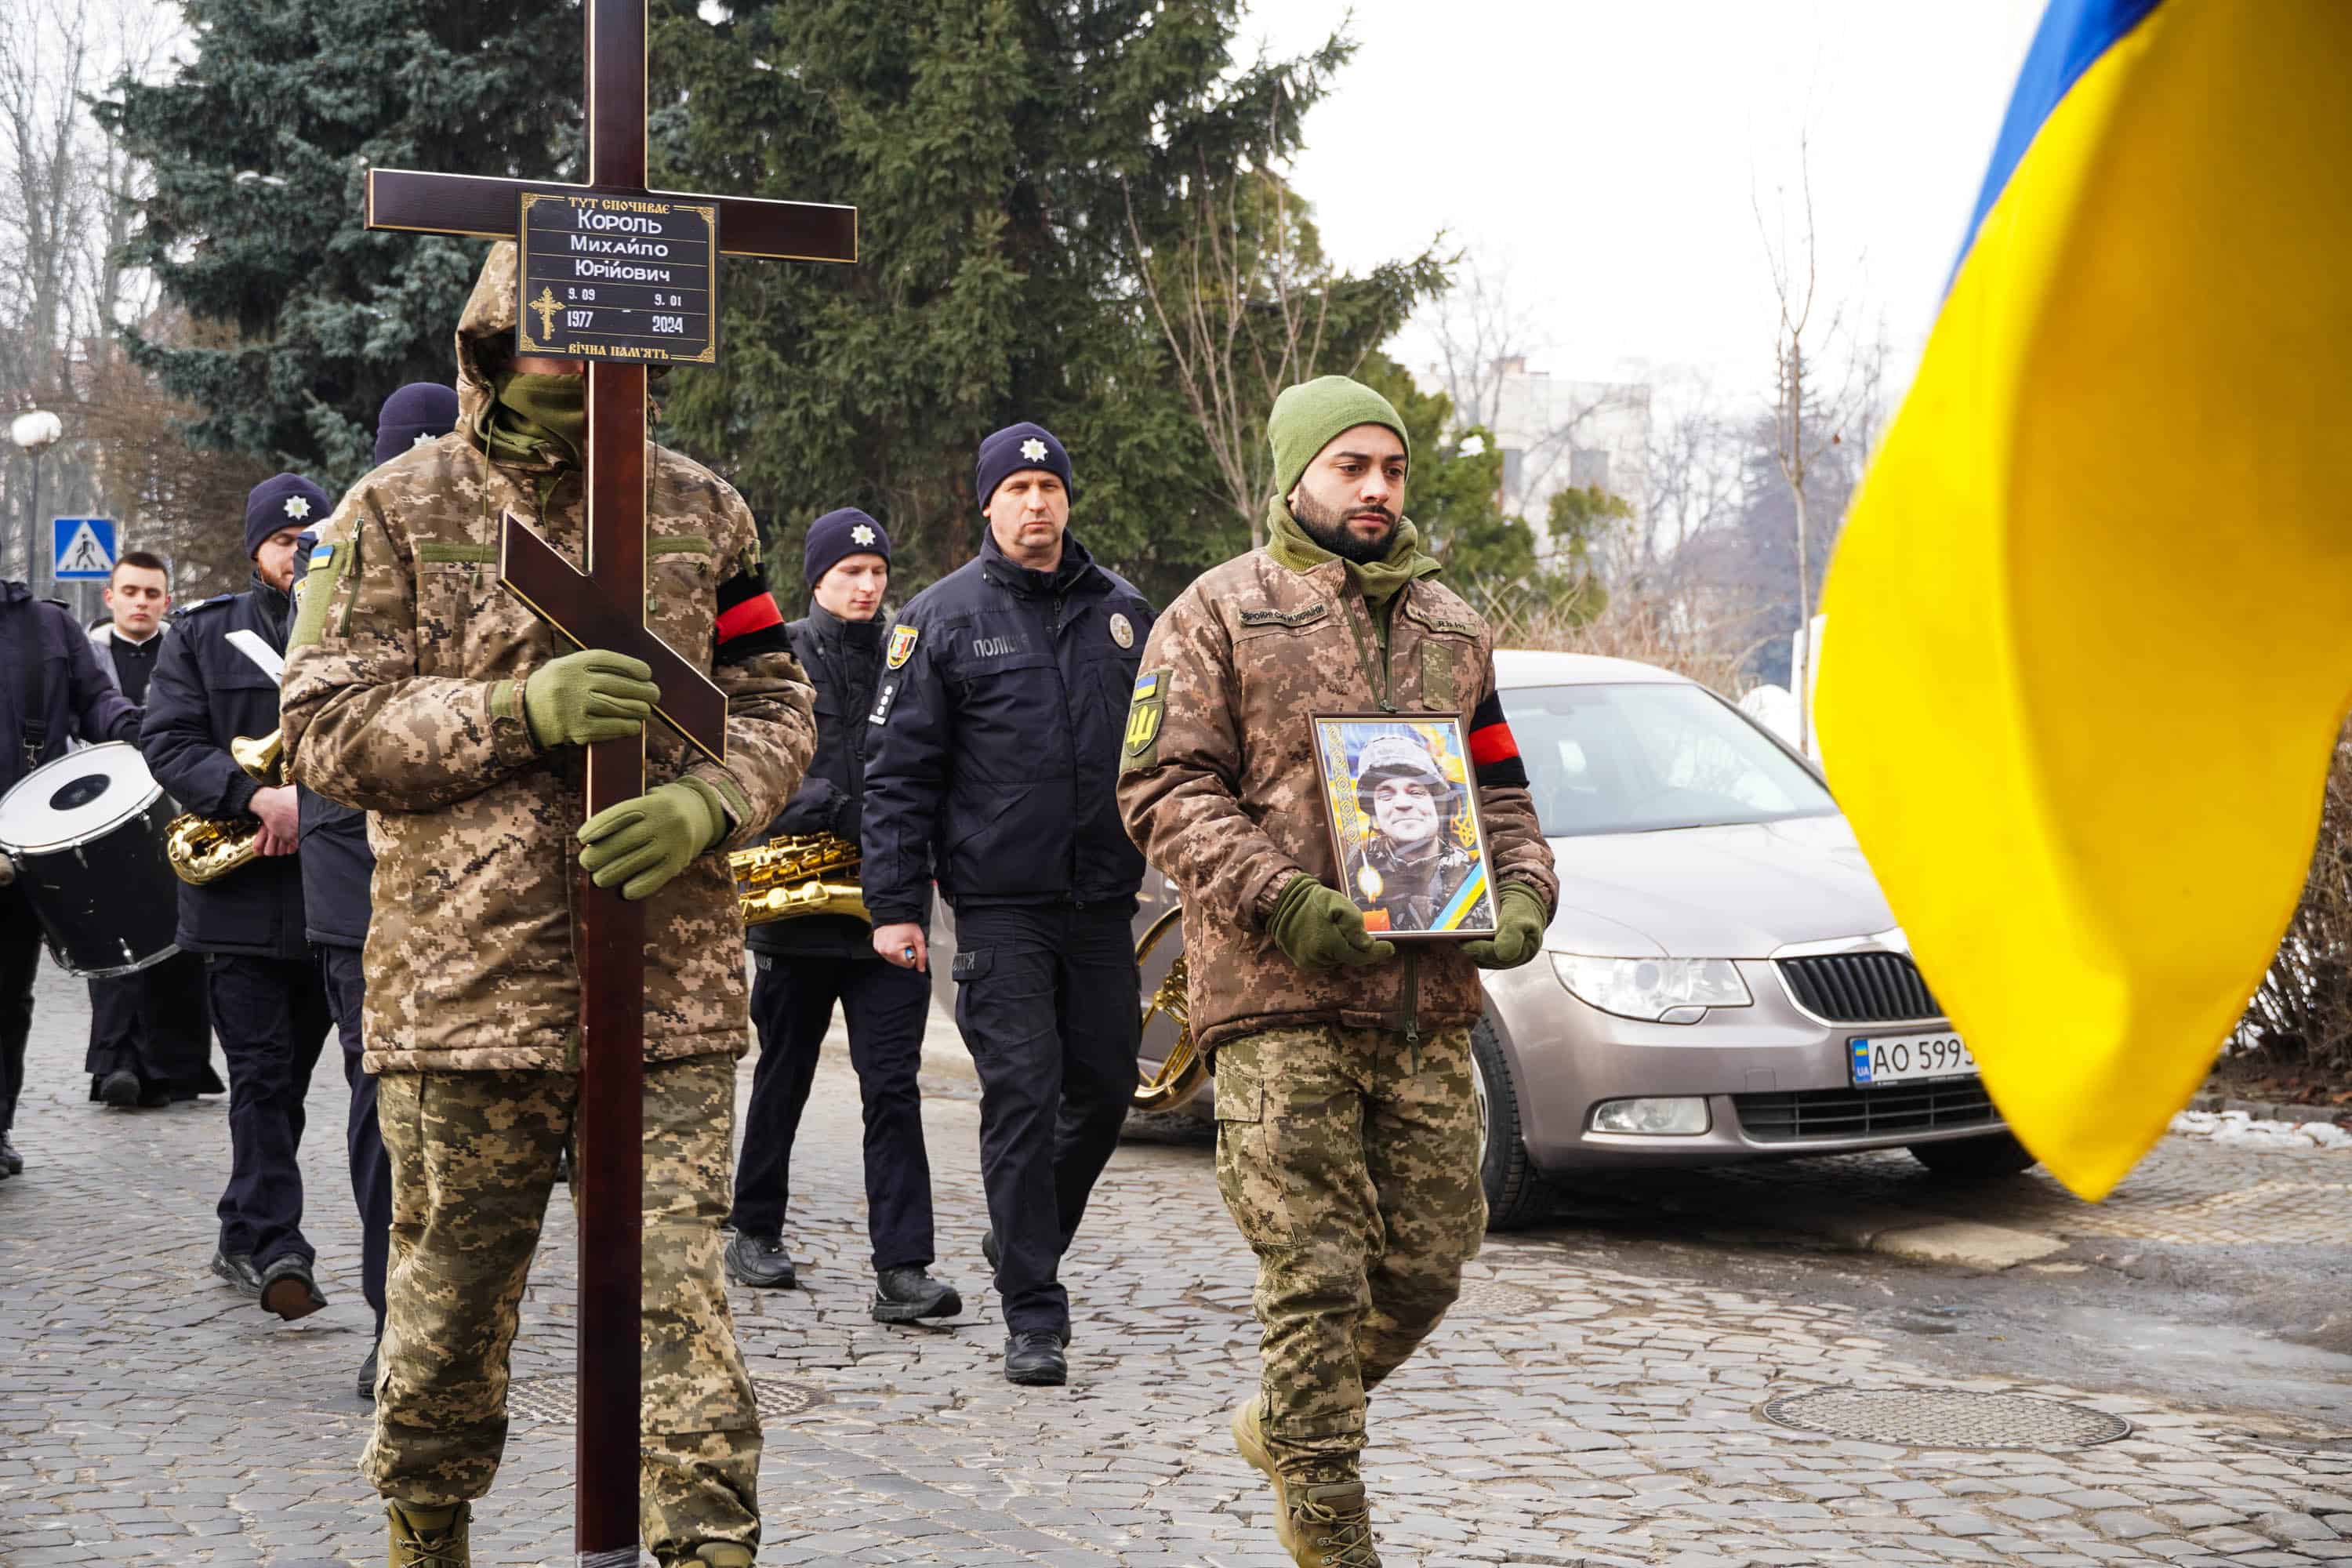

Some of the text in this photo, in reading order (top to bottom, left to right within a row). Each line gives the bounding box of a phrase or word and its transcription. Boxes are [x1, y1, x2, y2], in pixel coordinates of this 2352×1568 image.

[568, 197, 598, 209] ТУТ
[567, 311, 593, 328] 1977
[652, 315, 684, 333] 2024
[1874, 1044, 1909, 1075] AO
[1857, 1066, 1870, 1077] UA
